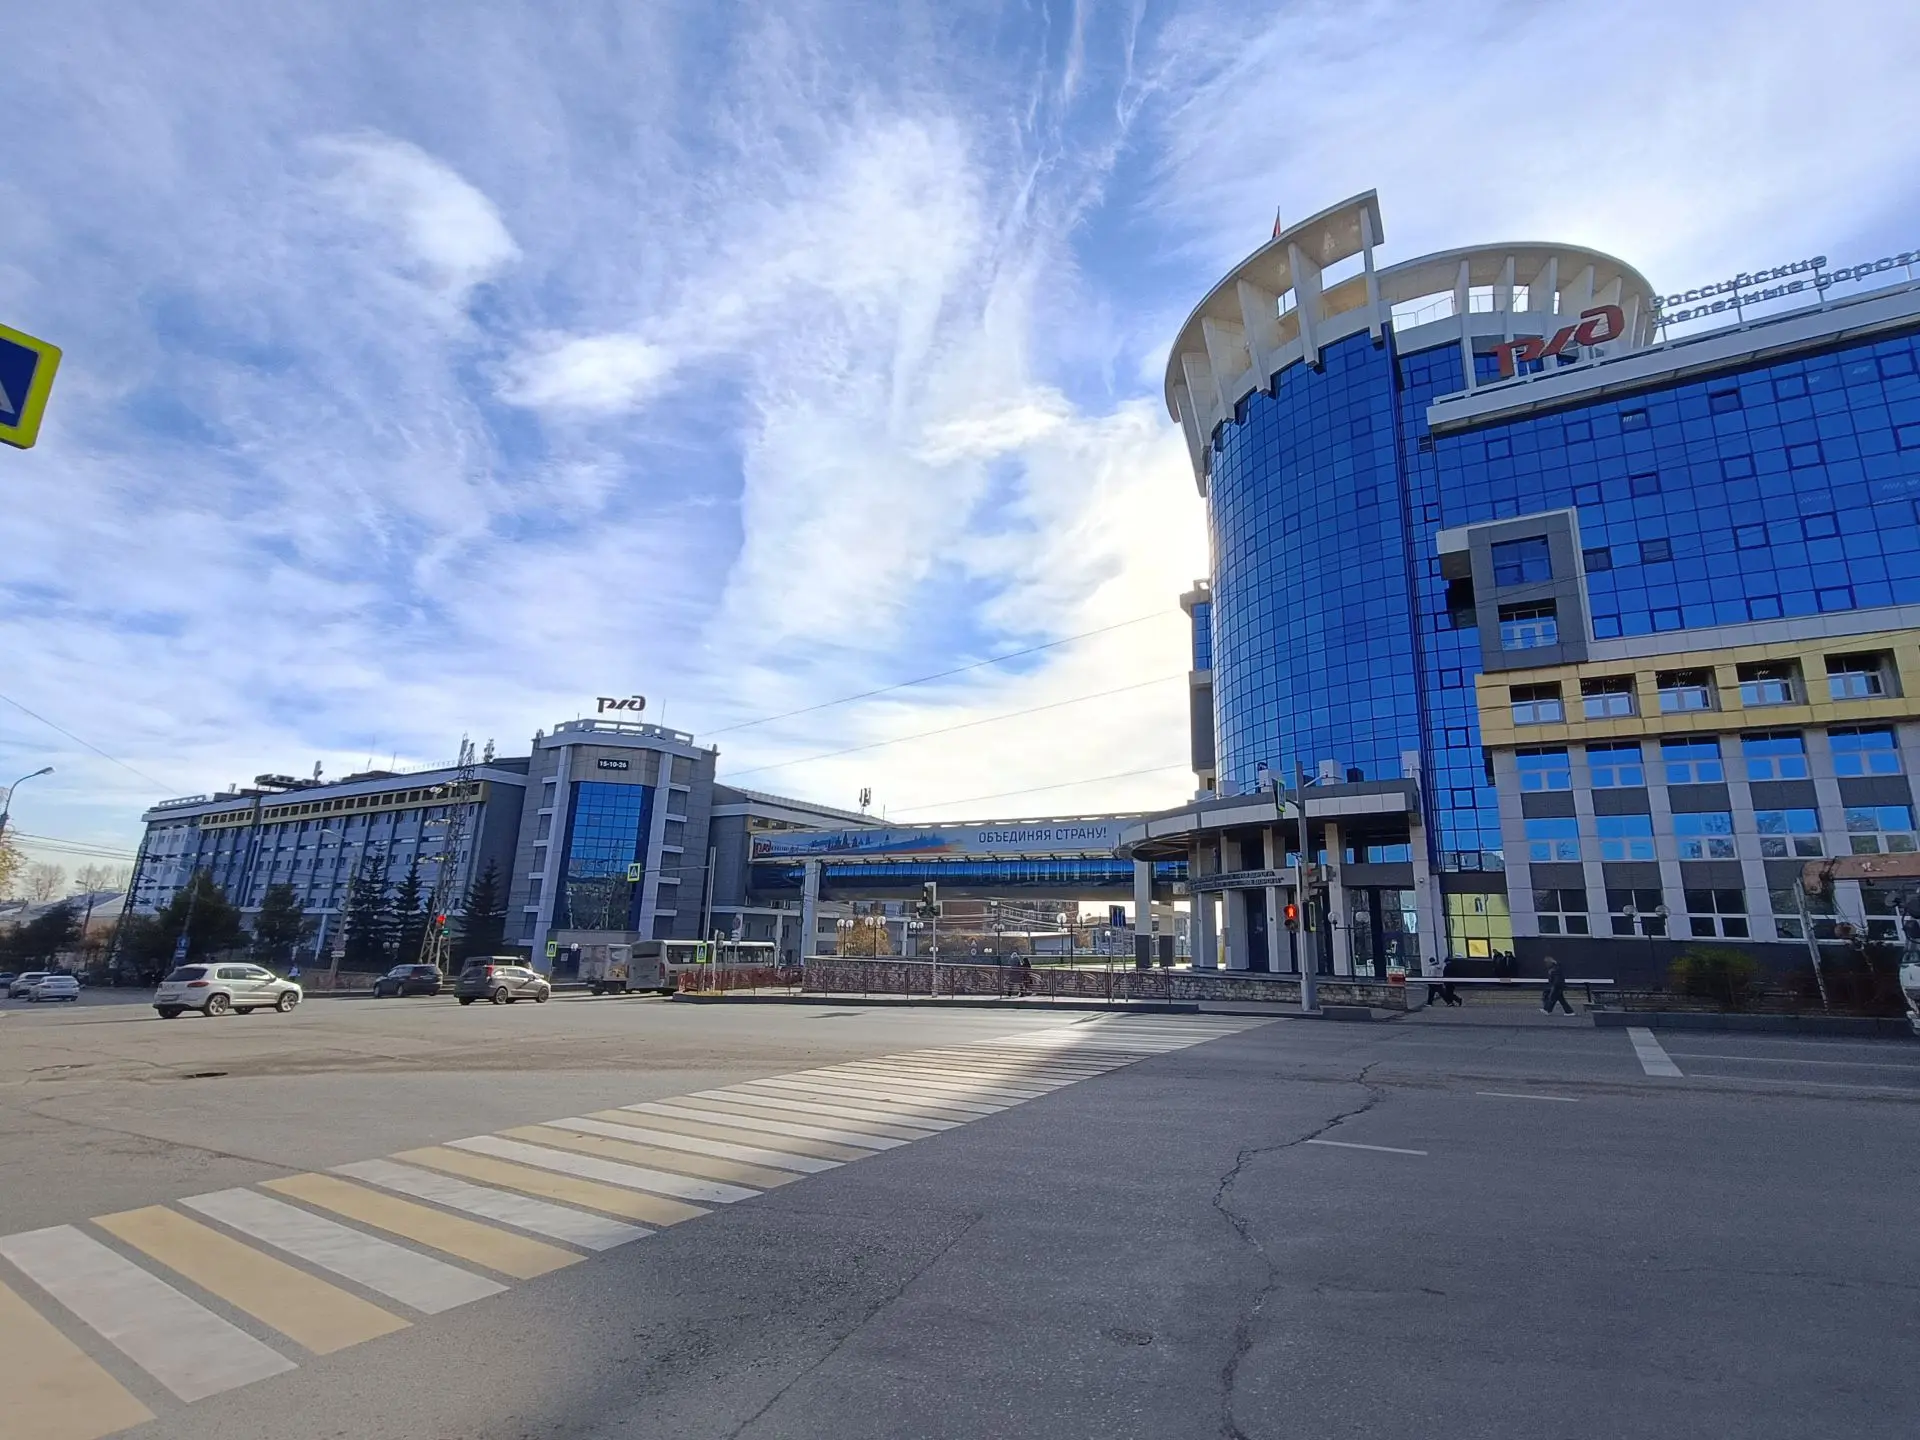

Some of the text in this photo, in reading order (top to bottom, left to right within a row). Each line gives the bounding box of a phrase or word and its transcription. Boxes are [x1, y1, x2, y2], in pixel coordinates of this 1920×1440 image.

[1649, 255, 1827, 311] Российские
[1652, 249, 1920, 328] железные дорог
[978, 826, 1107, 844] ОБЪЕДИНЯЯ СТРАНУ!
